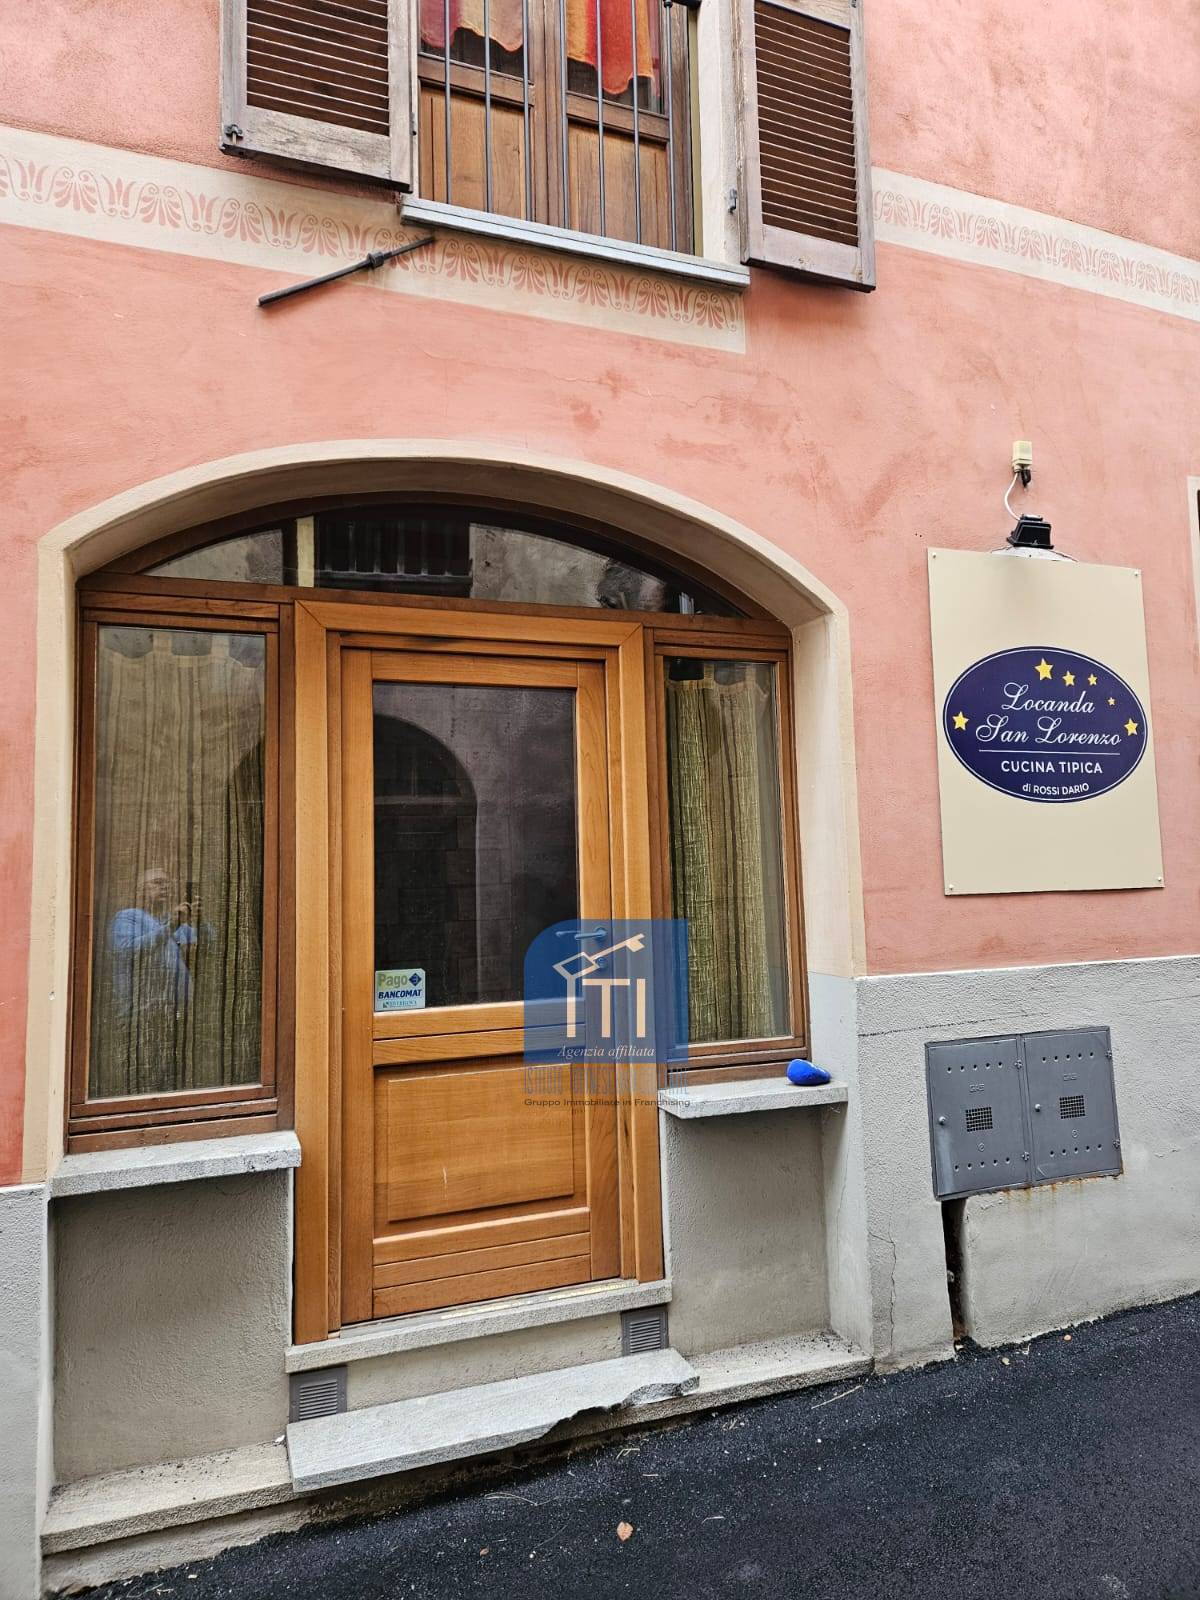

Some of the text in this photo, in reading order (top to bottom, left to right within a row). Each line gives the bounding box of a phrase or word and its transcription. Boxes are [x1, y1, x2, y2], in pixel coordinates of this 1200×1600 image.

[1001, 682, 1096, 713] Locanda
[975, 714, 1122, 746] San Lorenzo
[1001, 760, 1103, 774] CUCINA TIPICA
[1022, 783, 1090, 796] di ROSSI DARIO
[378, 973, 408, 988] Pago
[378, 989, 422, 1000] BANCOMAT
